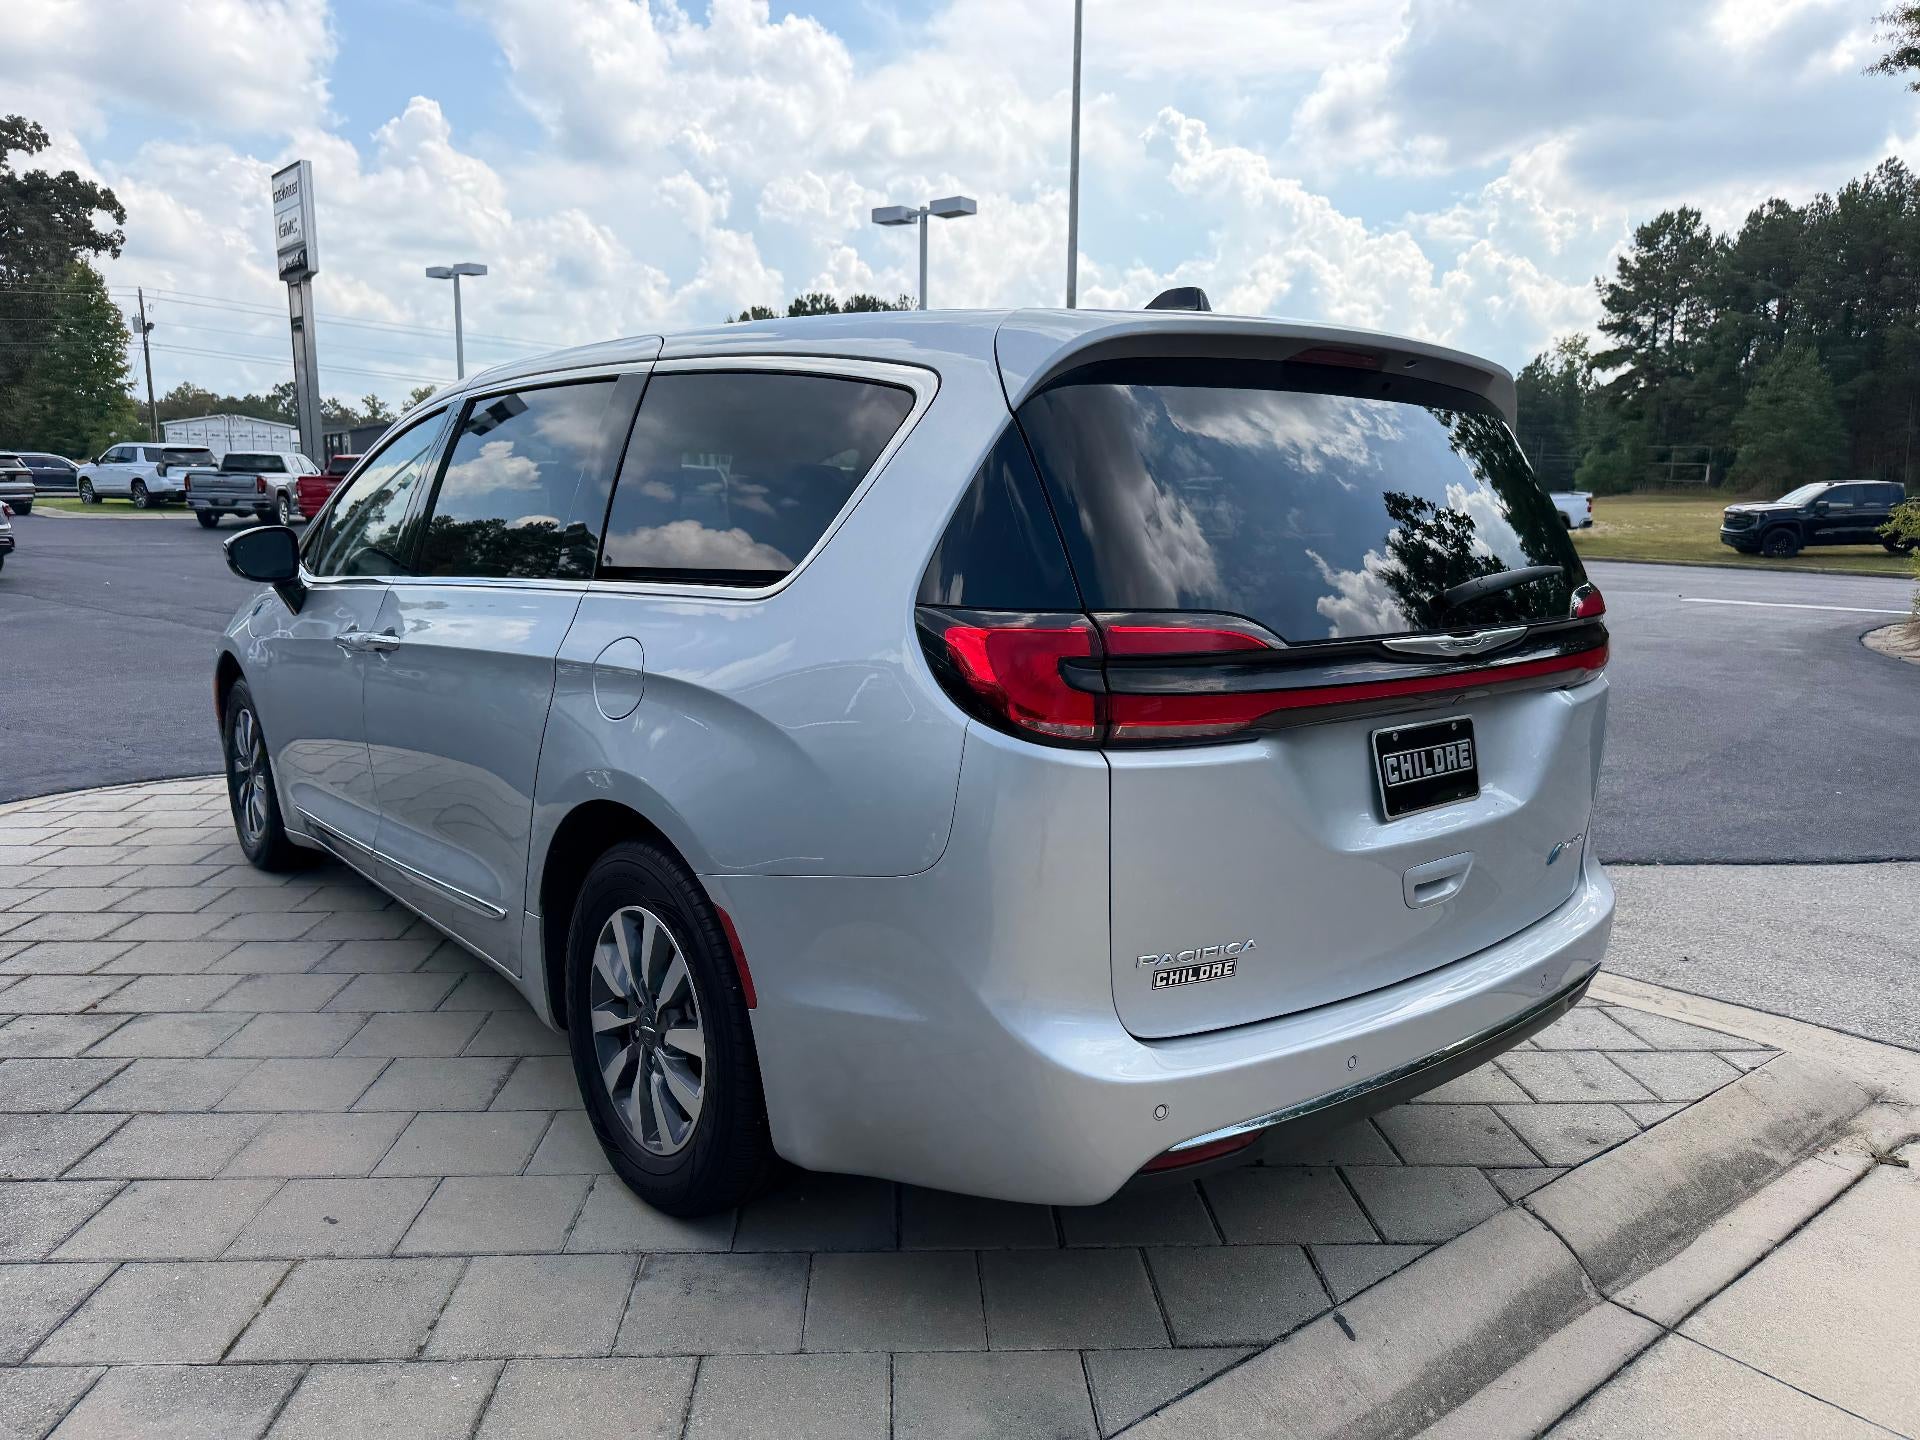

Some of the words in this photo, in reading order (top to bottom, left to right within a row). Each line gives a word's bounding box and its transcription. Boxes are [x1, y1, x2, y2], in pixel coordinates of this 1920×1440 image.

[279, 218, 298, 238] GMC
[1386, 743, 1470, 783] CHILDRE
[1136, 939, 1257, 968] PACIFICA
[1156, 962, 1235, 987] CHILDRE
